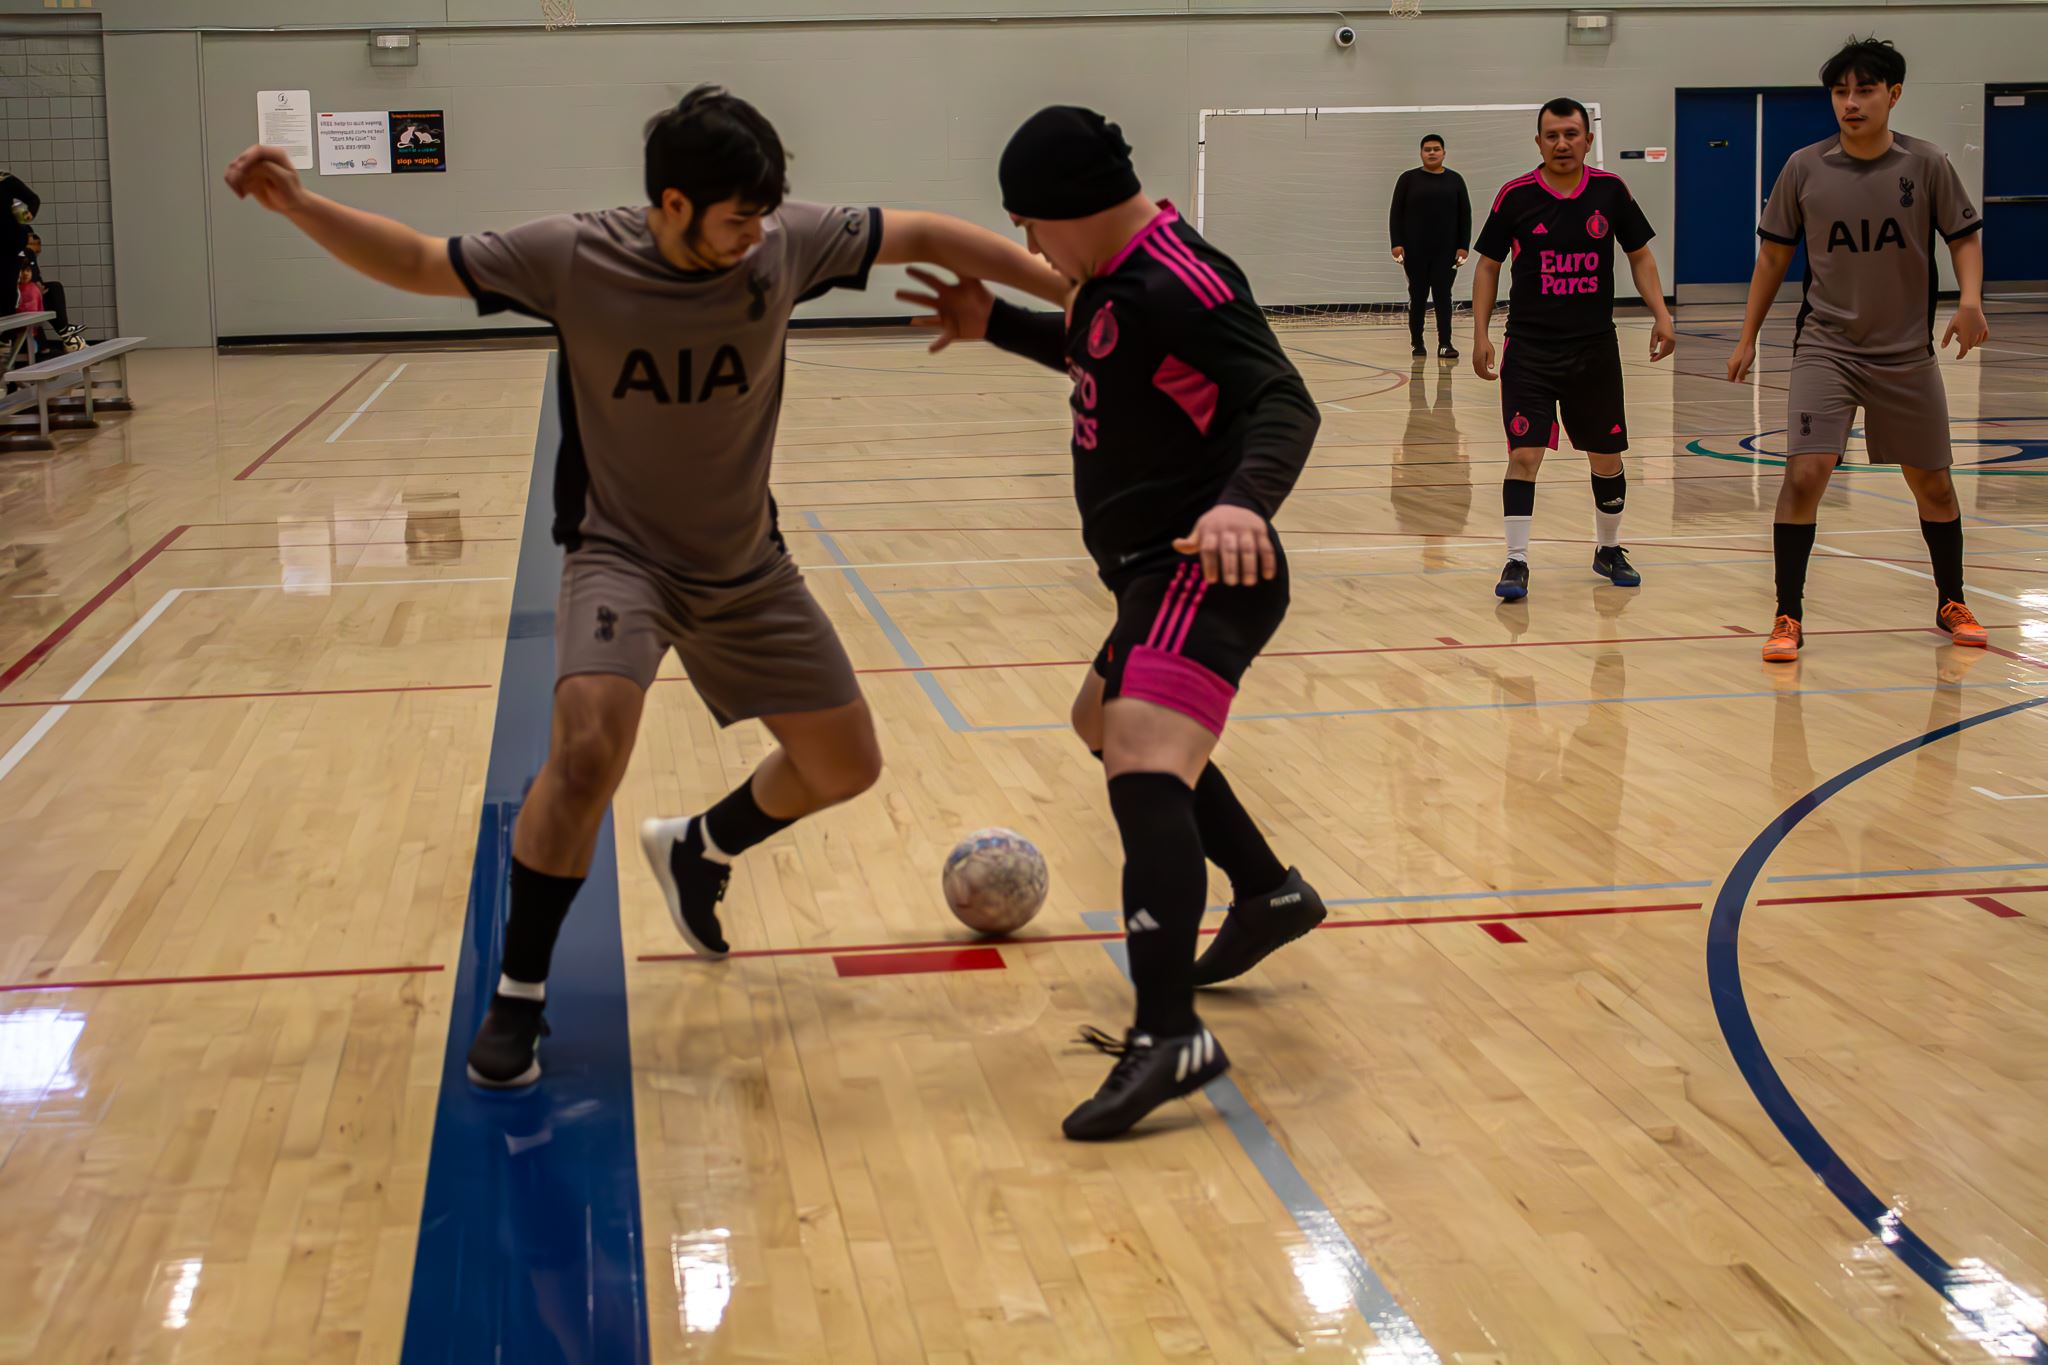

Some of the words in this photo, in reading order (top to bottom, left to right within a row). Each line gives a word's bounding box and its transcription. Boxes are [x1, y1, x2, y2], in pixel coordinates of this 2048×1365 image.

[414, 156, 439, 166] vaping
[1827, 217, 1907, 253] AIA
[1540, 250, 1600, 273] Euro
[1541, 274, 1599, 295] Parcs
[612, 344, 749, 404] AIA
